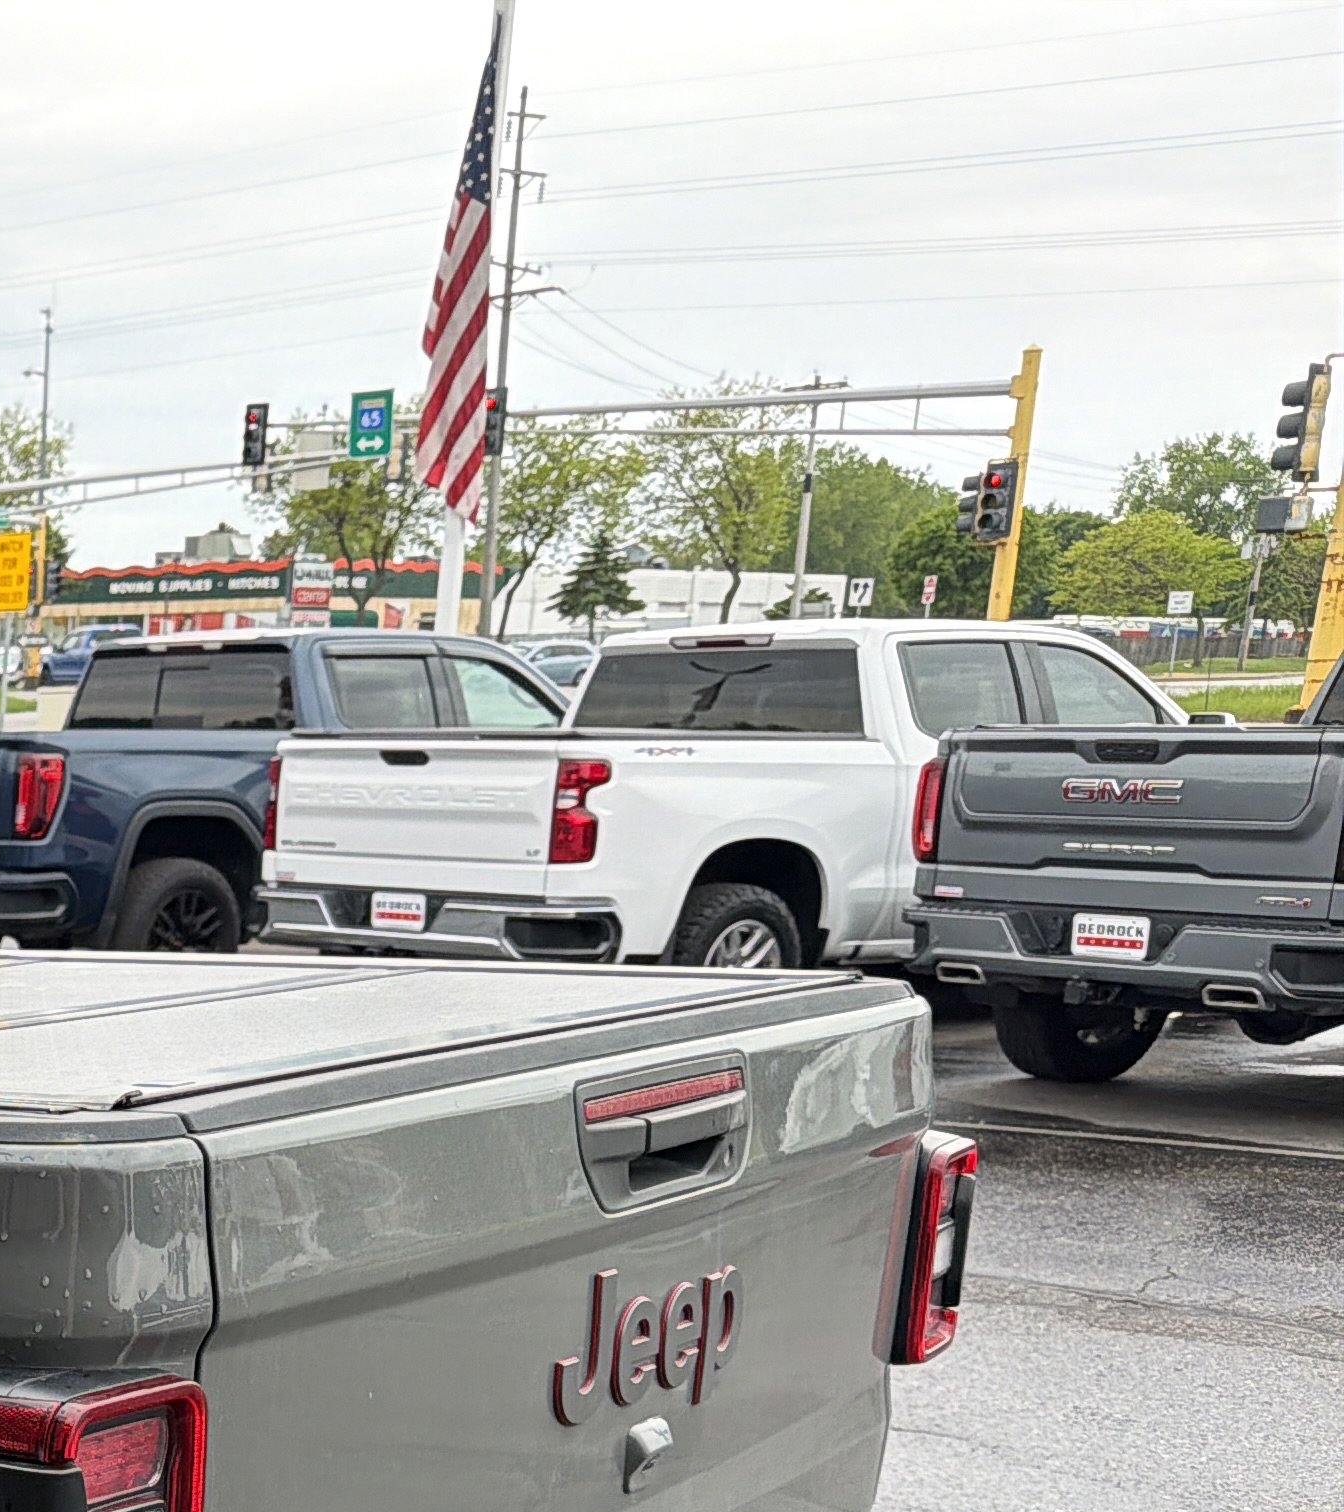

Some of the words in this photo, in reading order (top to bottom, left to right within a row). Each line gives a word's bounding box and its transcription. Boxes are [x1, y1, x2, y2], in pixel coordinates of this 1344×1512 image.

[361, 410, 382, 428] 65
[108, 580, 154, 594] MOVING
[158, 578, 213, 593] SUPPLIES
[291, 784, 528, 808] CHEVROLET
[1062, 778, 1184, 805] GMC
[1077, 923, 1145, 938] BEDROCK
[553, 1264, 744, 1427] Jeep
